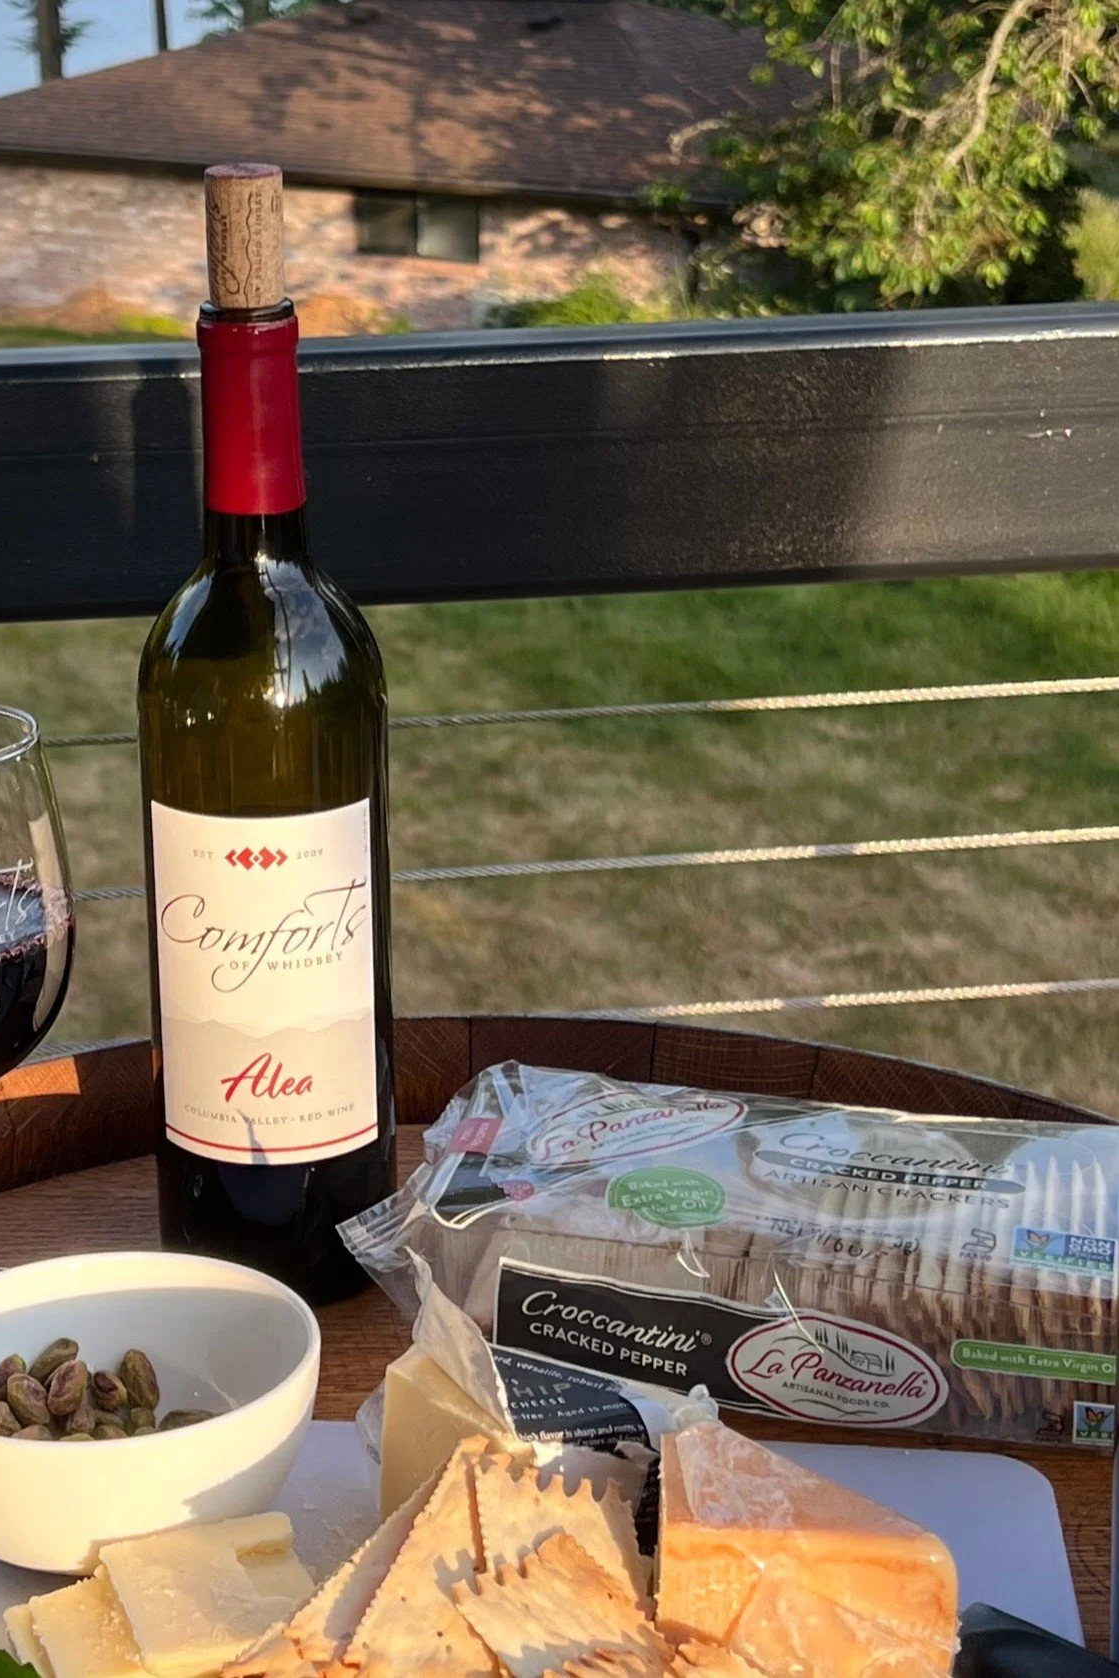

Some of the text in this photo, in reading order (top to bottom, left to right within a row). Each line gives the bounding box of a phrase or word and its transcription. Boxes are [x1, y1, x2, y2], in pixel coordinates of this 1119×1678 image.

[192, 848, 214, 860] EST
[161, 877, 367, 992] Comforts
[229, 951, 344, 972] OF WHIDBEY
[220, 1052, 314, 1103] Alea
[184, 1103, 355, 1126] COLUMBIA VALLEY RED WINE
[790, 1158, 987, 1189] CRACKED PEPPER
[622, 1189, 715, 1208] Extra Virgin
[763, 1169, 1011, 1209] ARTISAN CRACKERS
[682, 1198, 708, 1210] Oil
[1069, 1244, 1112, 1255] GMO
[1070, 1236, 1112, 1248] NON
[529, 1321, 689, 1377] CRACKED PEPPER
[962, 1347, 998, 1362] Baked
[1000, 1354, 1026, 1365] with
[1028, 1354, 1060, 1368] Extra
[1062, 1357, 1099, 1374] Virgin
[567, 1374, 604, 1390] robust
[742, 1349, 928, 1400] La Panzanella
[510, 1396, 566, 1410] CHEESE
[782, 1381, 835, 1400] ARTISANAL
[836, 1394, 870, 1408] FOODS
